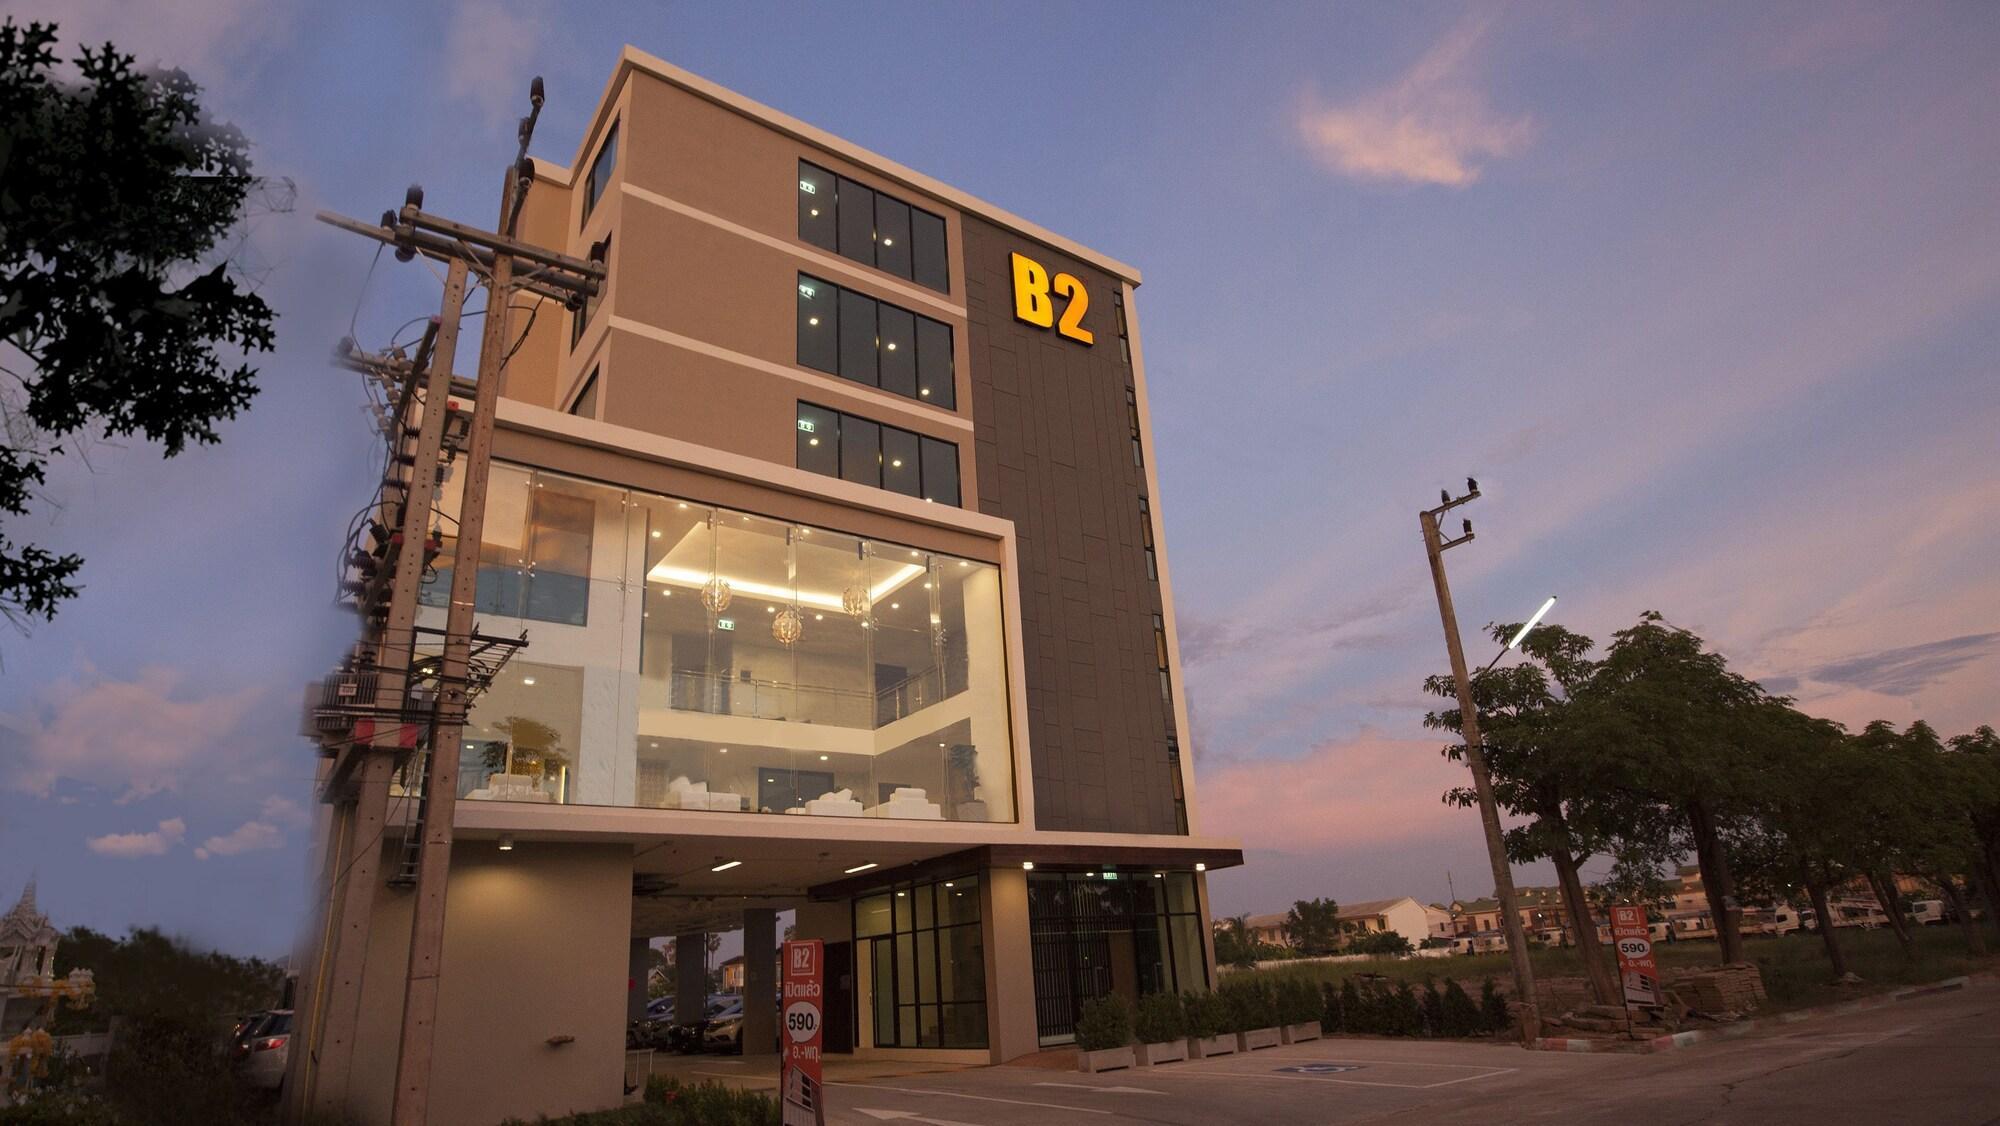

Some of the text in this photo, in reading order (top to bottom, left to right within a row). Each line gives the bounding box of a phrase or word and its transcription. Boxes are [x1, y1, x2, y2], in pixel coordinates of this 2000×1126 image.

[1010, 251, 1094, 347] B2
[1619, 910, 1635, 921] B2
[793, 948, 810, 968] B2
[785, 980, 820, 998] เปิดแล้ว
